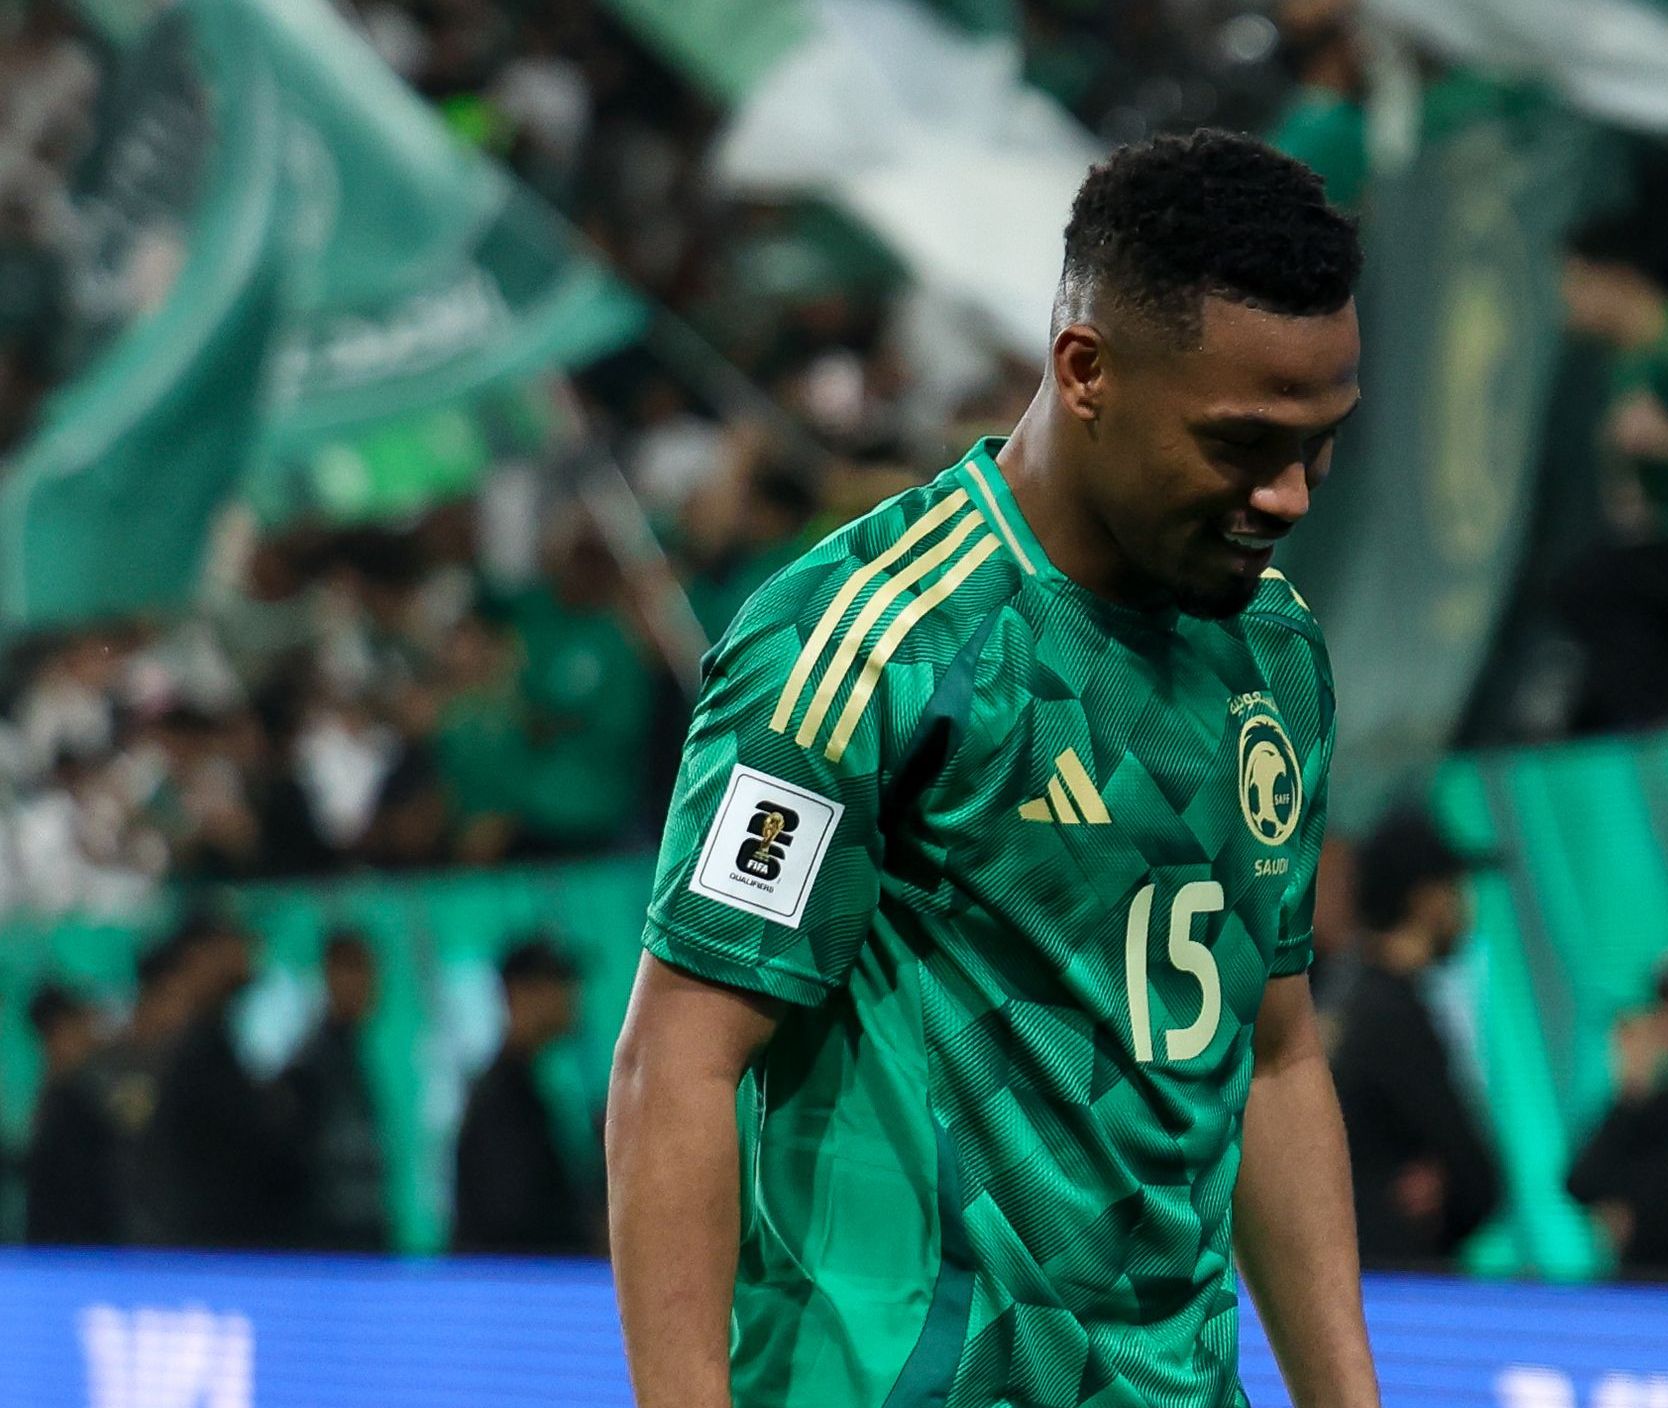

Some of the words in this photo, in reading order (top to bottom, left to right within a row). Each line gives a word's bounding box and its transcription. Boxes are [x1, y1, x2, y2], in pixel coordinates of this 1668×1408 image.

[1274, 794, 1290, 805] SAFF
[746, 860, 769, 875] FIFA
[1255, 858, 1289, 877] SAUDI
[729, 872, 775, 893] QUALIFIERS
[1126, 880, 1225, 1062] 15
